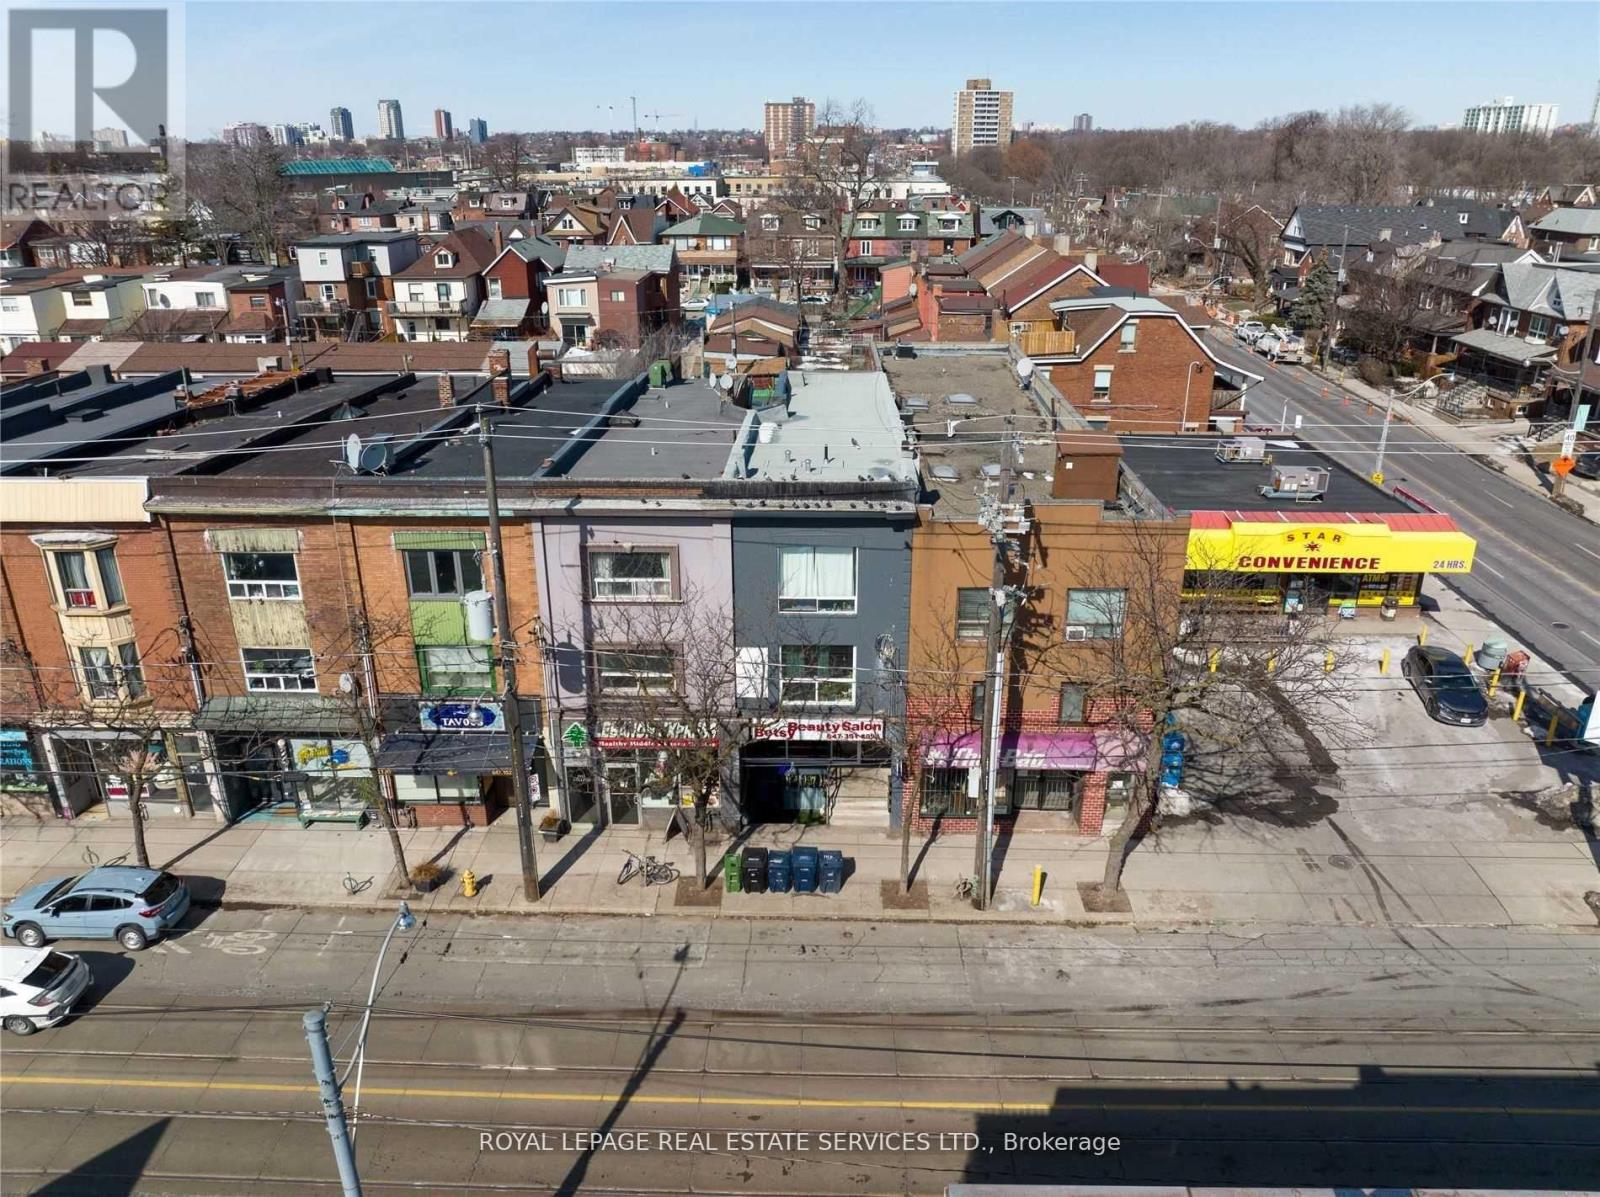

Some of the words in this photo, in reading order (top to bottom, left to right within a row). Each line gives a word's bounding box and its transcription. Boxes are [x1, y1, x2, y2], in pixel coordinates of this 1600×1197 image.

[1287, 531, 1342, 543] STAR
[1238, 555, 1381, 570] CONVENIENCE
[1433, 560, 1446, 569] 24
[1446, 560, 1468, 569] HRS.
[755, 726, 796, 740] Betsy
[787, 721, 839, 737] Beauty
[841, 721, 882, 732] Salon
